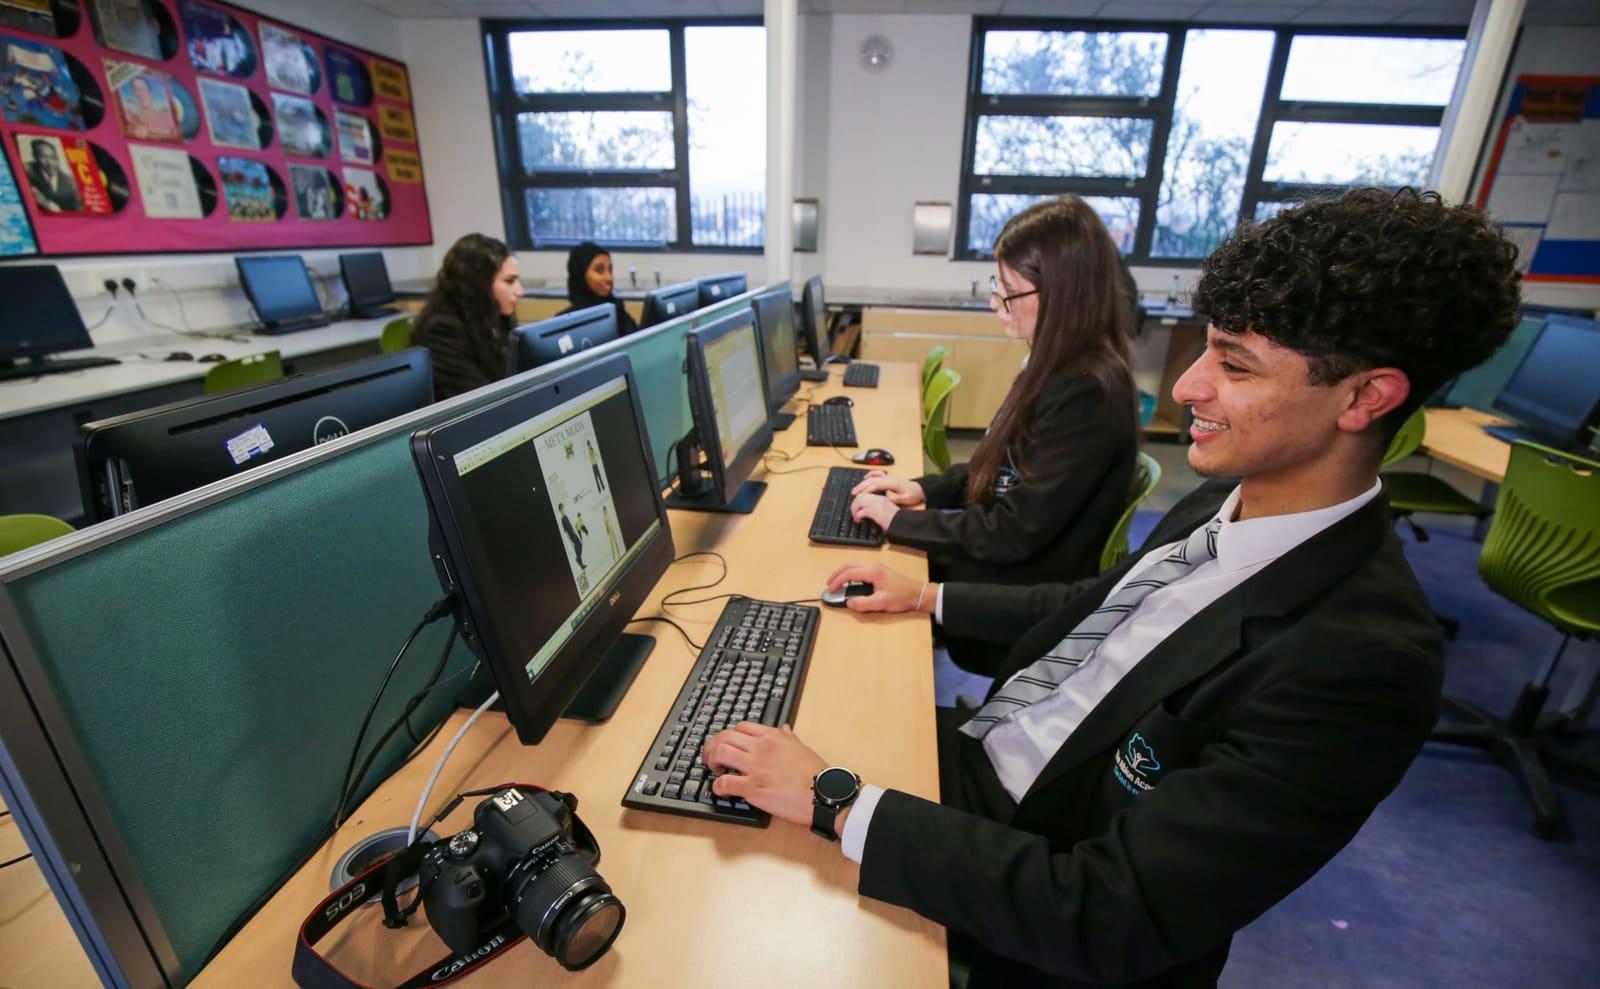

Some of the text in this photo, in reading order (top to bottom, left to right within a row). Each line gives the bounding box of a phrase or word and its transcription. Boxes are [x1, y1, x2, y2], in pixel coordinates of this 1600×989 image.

[532, 834, 560, 855] Canon
[325, 883, 366, 922] EOS
[431, 935, 504, 981] Canon
